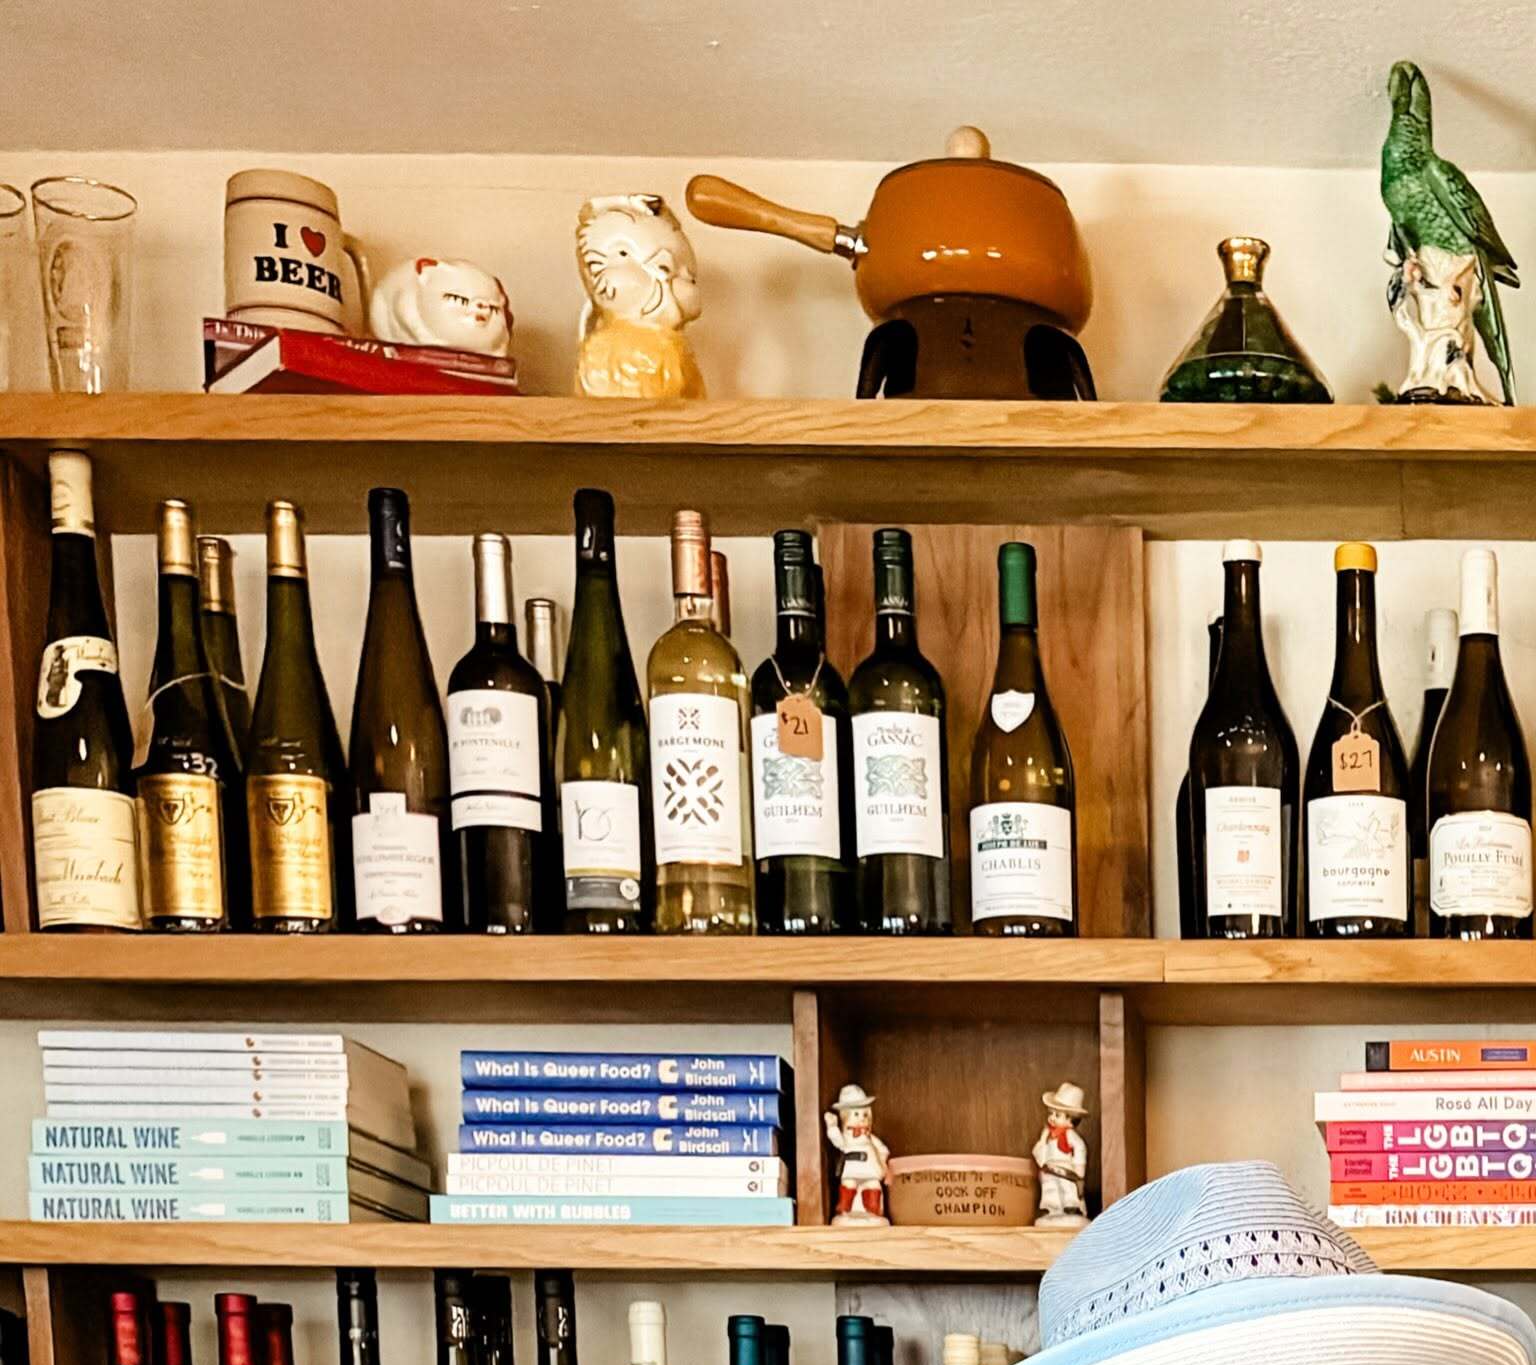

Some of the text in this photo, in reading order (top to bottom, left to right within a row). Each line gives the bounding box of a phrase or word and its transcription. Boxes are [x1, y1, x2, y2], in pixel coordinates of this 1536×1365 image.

[273, 222, 289, 249] I
[253, 255, 344, 304] BEER
[1338, 749, 1374, 772] $27
[690, 1057, 726, 1072] John
[1409, 1048, 1462, 1063] AUSTIN
[475, 1060, 652, 1080] What Is Queer Food?
[684, 1072, 737, 1088] Birdsall
[475, 1096, 652, 1117] What Is Queer Food?
[690, 1093, 726, 1108] John
[1434, 1096, 1535, 1114] Rosé All Day
[684, 1108, 737, 1123] Birdsall
[44, 1125, 182, 1150] NATURAL WINE
[472, 1129, 647, 1150] What Is Queer Food?
[684, 1126, 721, 1139] John
[678, 1138, 731, 1154] Birdsall
[40, 1161, 180, 1186] NATURAL WINE
[42, 1196, 181, 1221] NATURAL WINE
[934, 1202, 1006, 1217] CHAMPION
